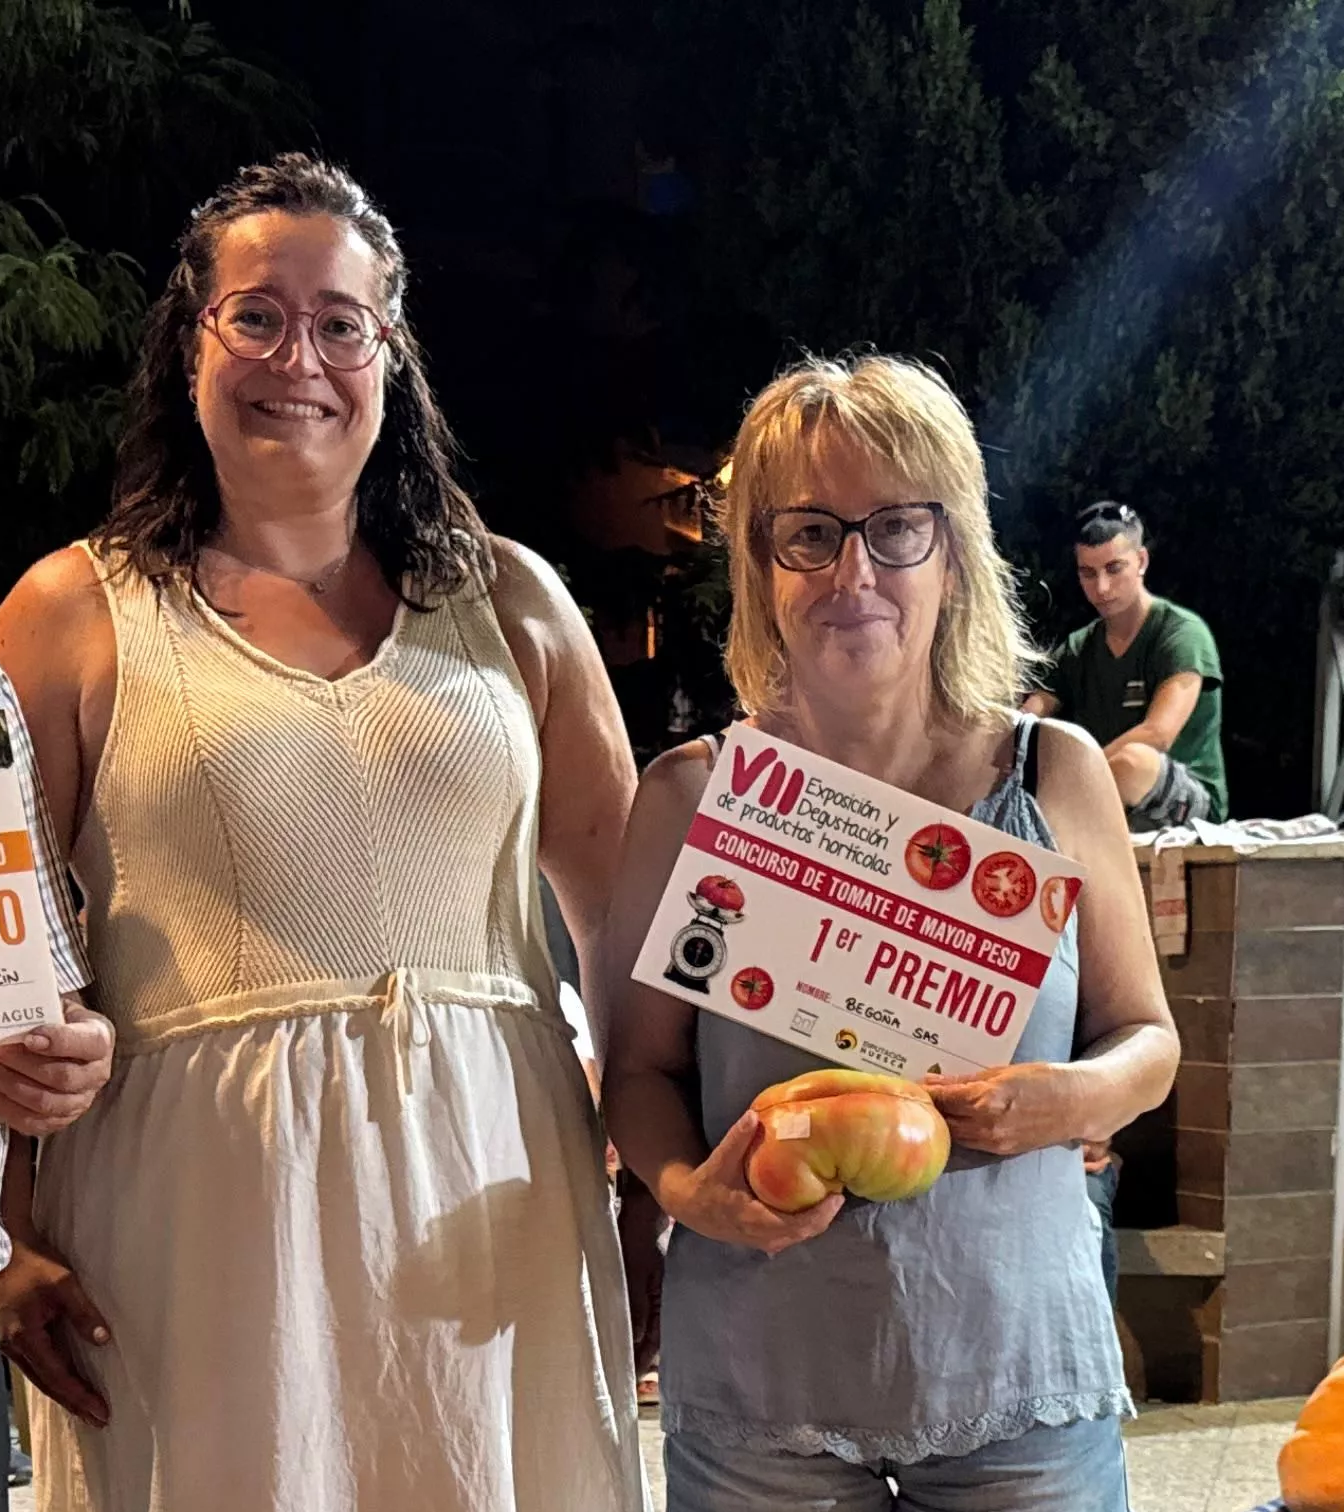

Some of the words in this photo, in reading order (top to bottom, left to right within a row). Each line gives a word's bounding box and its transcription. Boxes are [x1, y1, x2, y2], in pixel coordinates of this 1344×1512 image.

[732, 745, 804, 816] VII
[805, 777, 881, 822] Exposición
[717, 792, 737, 812] de
[739, 802, 815, 844] productos
[819, 831, 893, 876] hortícolas
[796, 798, 889, 850] Degustación
[714, 831, 799, 881] CONCURSO
[801, 867, 827, 893] DE
[828, 876, 891, 919] TOMATE
[894, 903, 921, 929] DE
[918, 914, 975, 954] MAYOR
[978, 938, 1021, 972] PESO
[845, 997, 901, 1029] BEGOÑA
[912, 1027, 939, 1045] SAS
[864, 940, 1016, 1037] PREMIO
[860, 1047, 905, 1069] HUESCA
